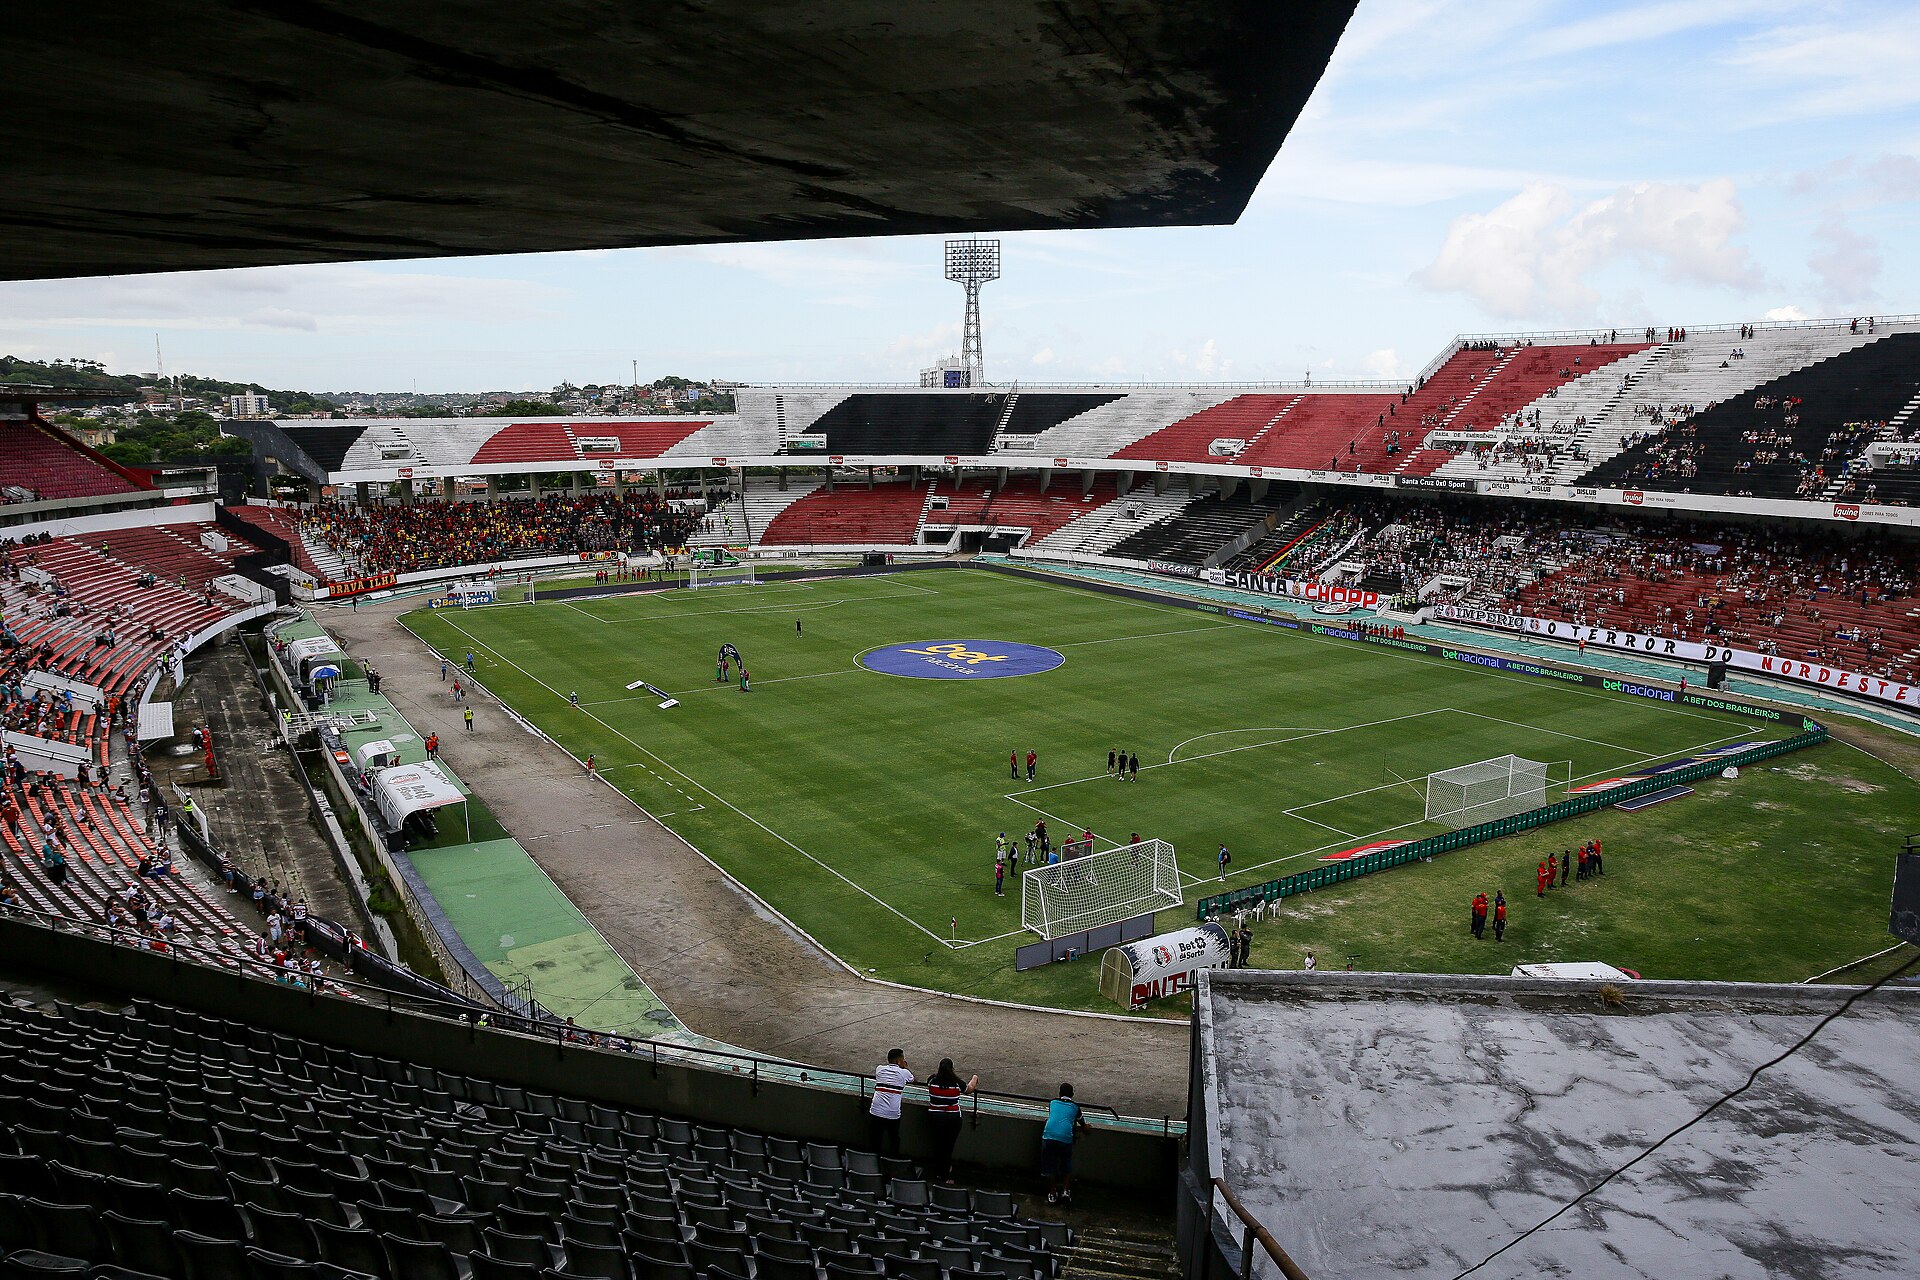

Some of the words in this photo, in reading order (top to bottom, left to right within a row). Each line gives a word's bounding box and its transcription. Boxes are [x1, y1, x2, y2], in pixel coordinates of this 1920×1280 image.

[1834, 506, 1858, 517] Iquine
[330, 580, 364, 594] BRAVA
[370, 574, 396, 588] ILHA
[1224, 570, 1288, 594] SANTA
[1306, 583, 1378, 608] CHOPP
[1312, 624, 1359, 640] betnacional
[1392, 640, 1427, 652] BRASILEIROS
[1442, 648, 1500, 668] betnacional
[1540, 668, 1583, 682] BRASILEIROS
[1548, 622, 1556, 634] O
[1571, 624, 1676, 654] TERROR
[1704, 646, 1733, 662] DO
[1762, 656, 1909, 700] NORDESTE
[1603, 678, 1674, 702] betnacional
[1690, 696, 1706, 705] BET
[1708, 699, 1725, 709] DOS
[1726, 704, 1780, 720] BRASILEIROS
[1179, 941, 1196, 952] Bet
[1186, 950, 1204, 960] Sorte
